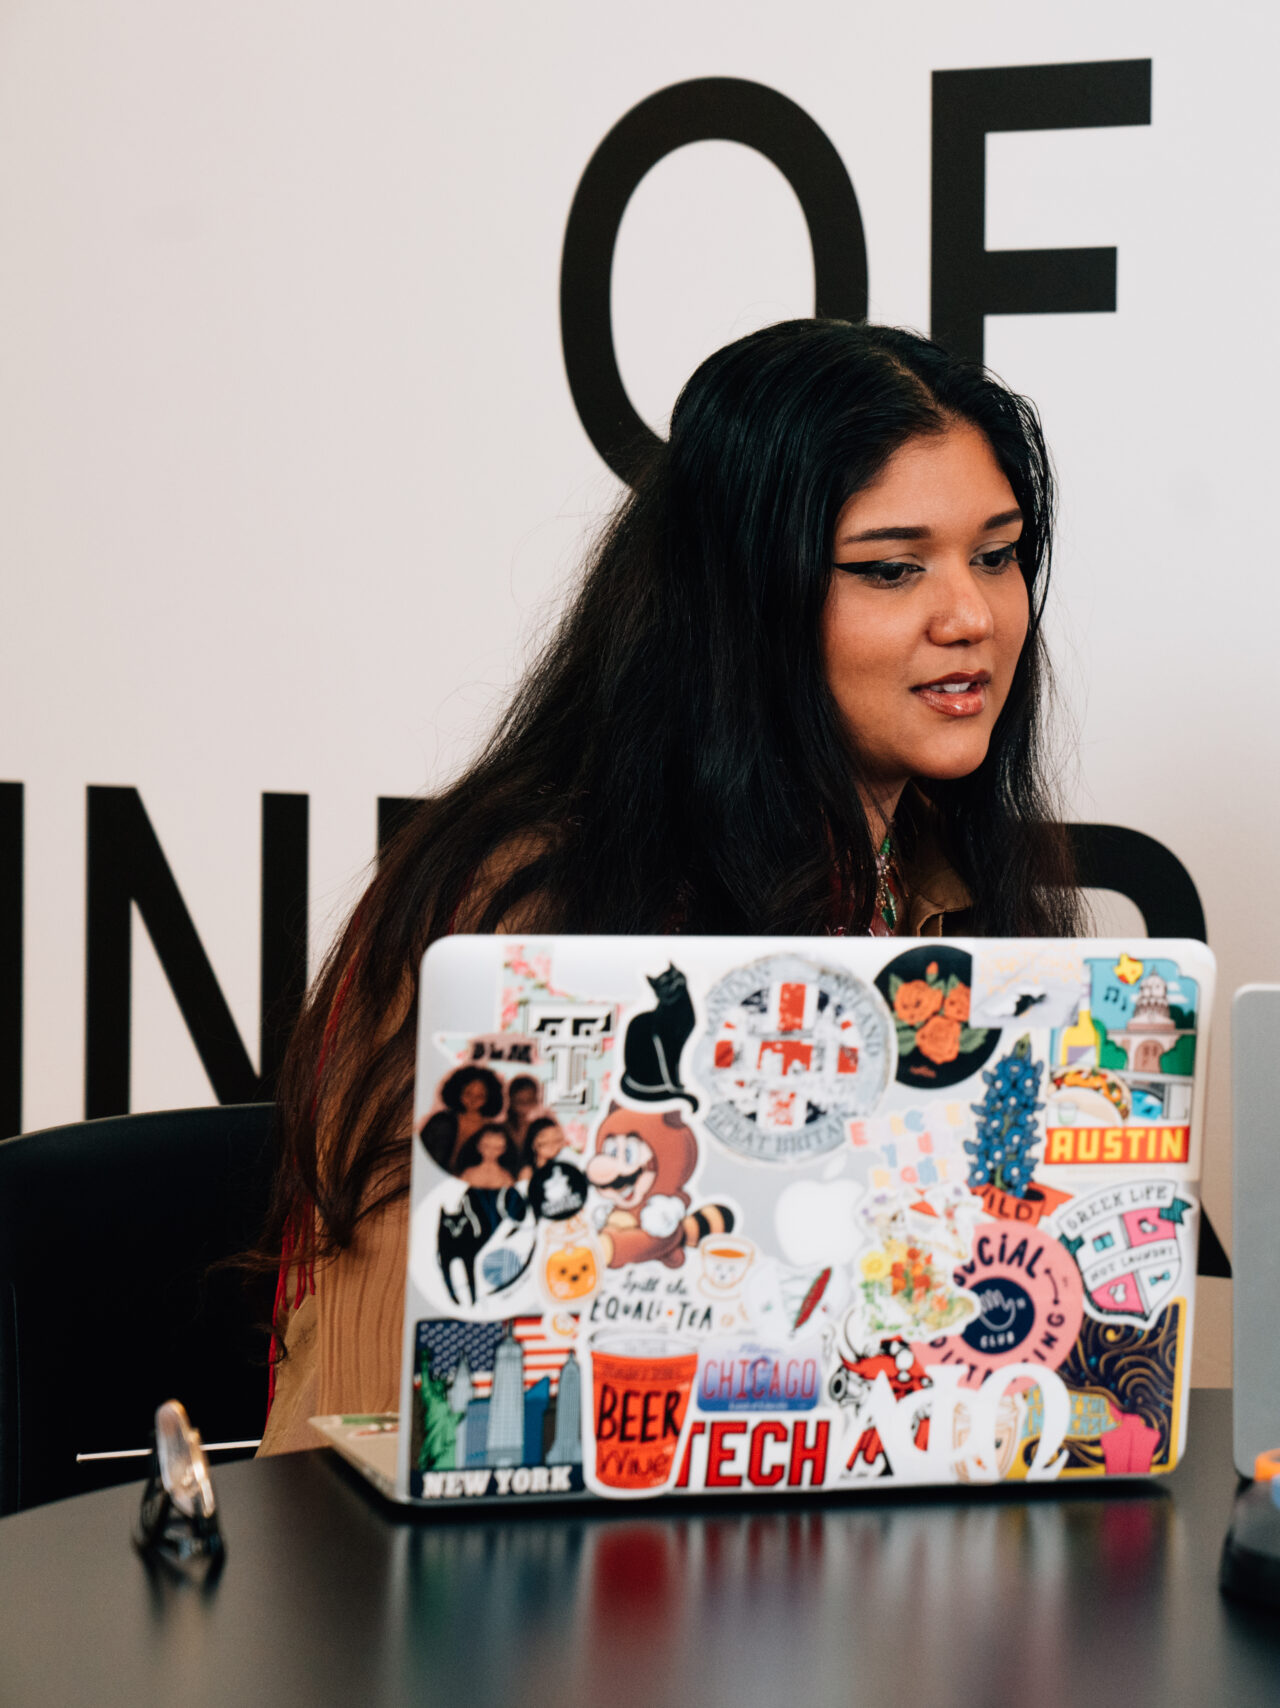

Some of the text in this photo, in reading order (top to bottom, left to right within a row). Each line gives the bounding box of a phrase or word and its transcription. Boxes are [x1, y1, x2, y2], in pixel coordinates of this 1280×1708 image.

[560, 57, 1153, 495] OF
[1051, 1128, 1184, 1161] AUSTIN
[1066, 1191, 1123, 1230] GREEK
[702, 1358, 817, 1399] CHICAGO
[597, 1384, 683, 1443] BEER
[422, 1465, 573, 1499] NEW YORK
